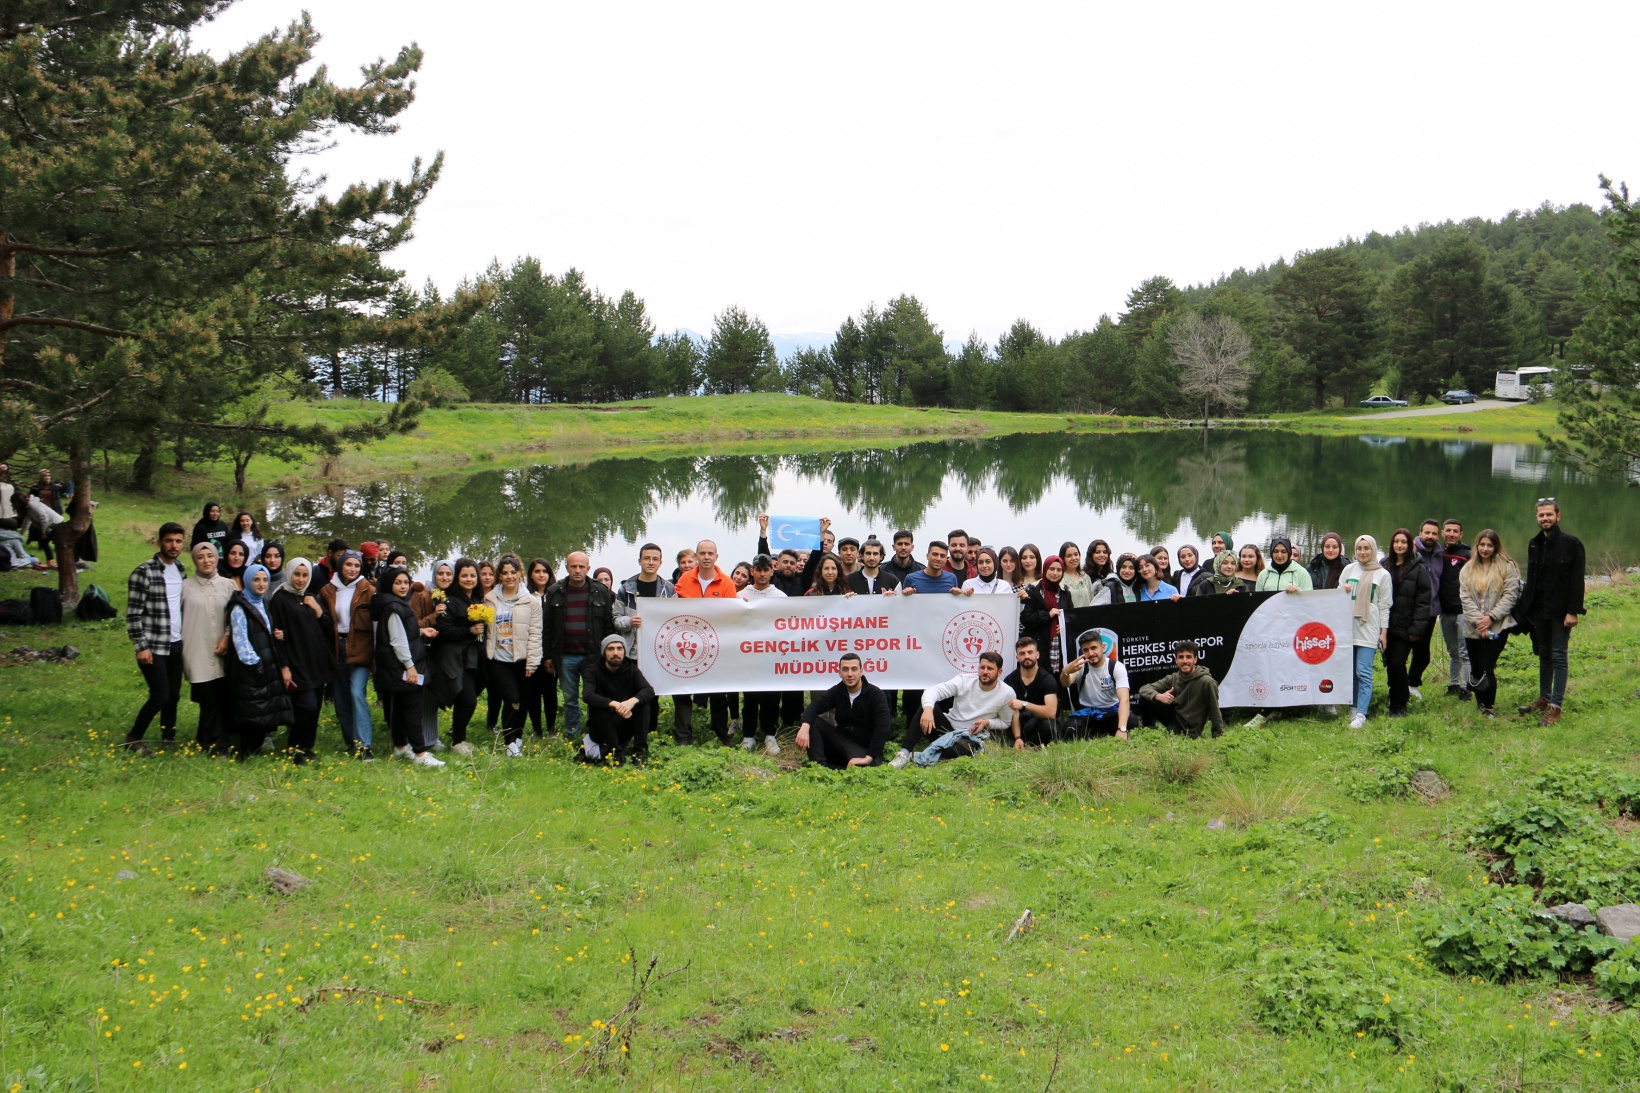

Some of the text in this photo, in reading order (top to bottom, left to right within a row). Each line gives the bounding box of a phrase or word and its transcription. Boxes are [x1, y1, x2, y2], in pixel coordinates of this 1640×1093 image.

[774, 615, 888, 632] GÜMÜŞHANE
[740, 634, 922, 655] GENÇLİK VE SPOR İL
[1122, 642, 1165, 656] HERKES
[1194, 636, 1224, 648] SPOR
[1296, 635, 1333, 652] hisset
[774, 658, 888, 675] MÜDÜRĞÜ
